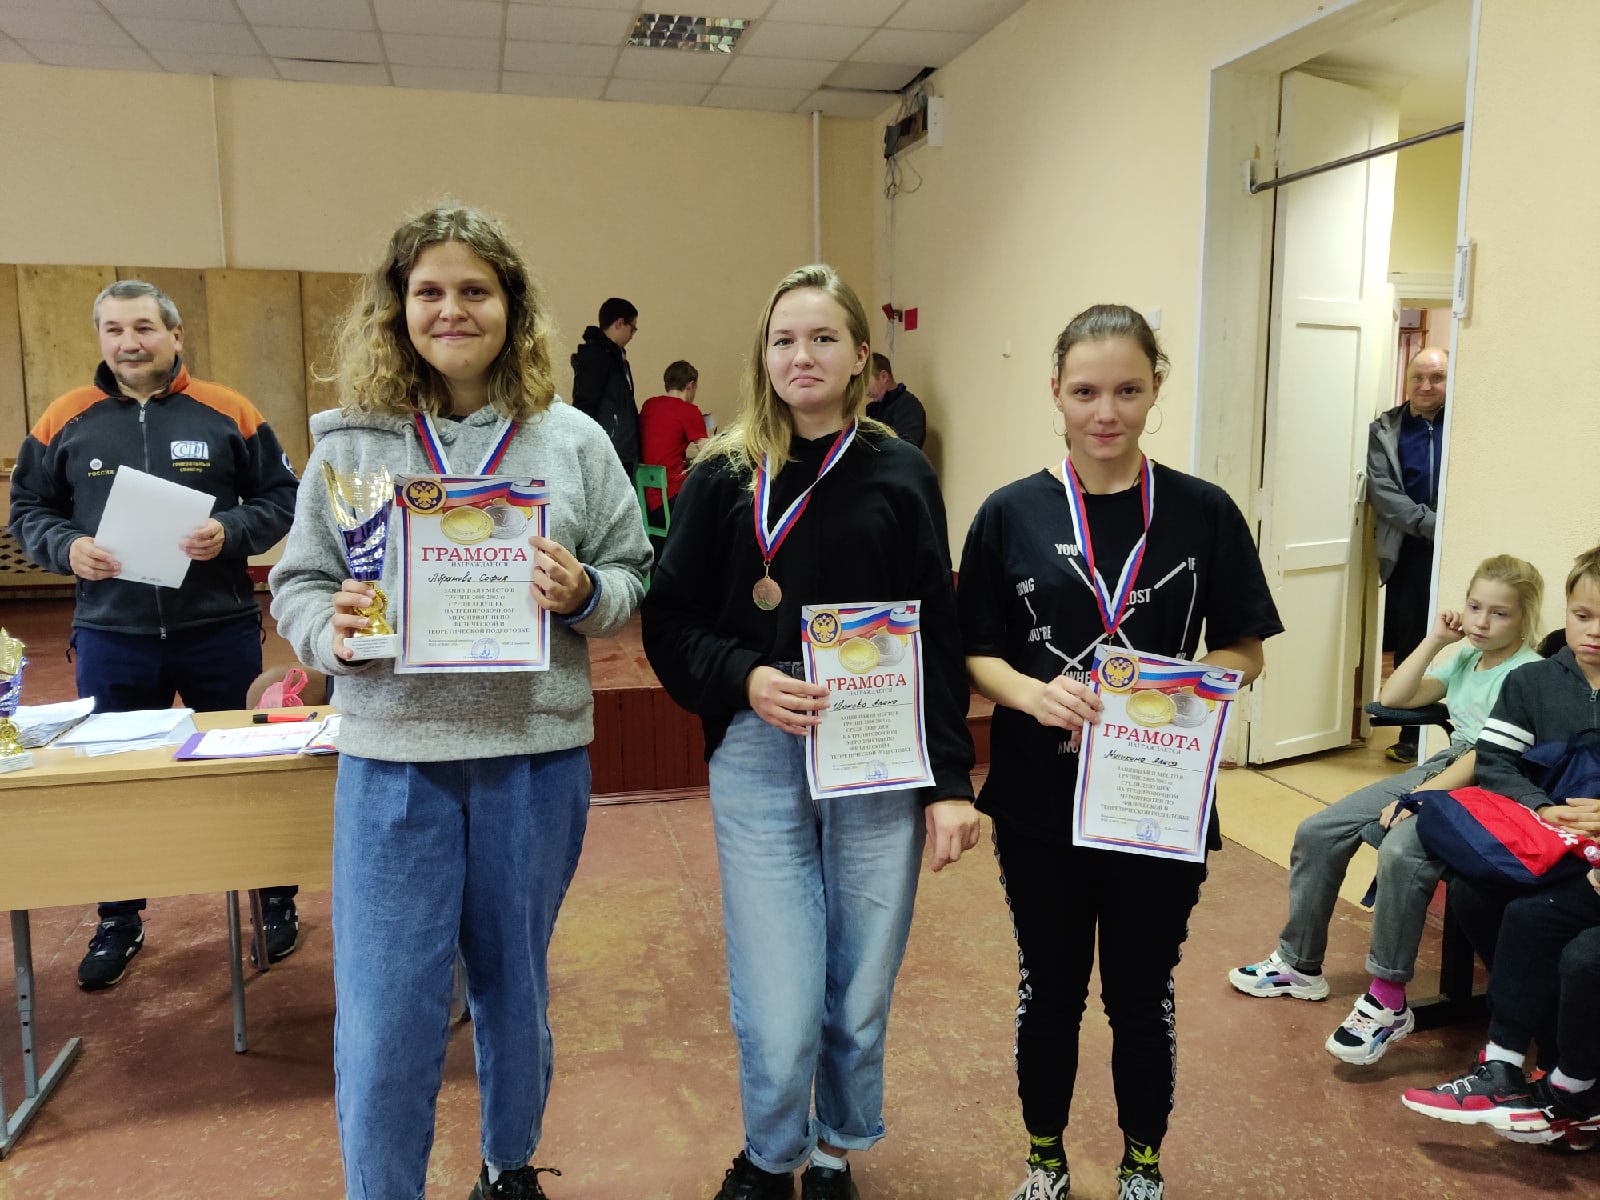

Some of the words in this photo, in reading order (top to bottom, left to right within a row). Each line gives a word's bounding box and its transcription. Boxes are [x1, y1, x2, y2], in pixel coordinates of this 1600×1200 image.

[421, 547, 528, 561] ГРАМОТА
[1054, 543, 1078, 556] YOU
[1125, 588, 1151, 605] OST
[826, 673, 907, 691] ГРАМОТА
[1103, 723, 1201, 751] ГРАМОТА
